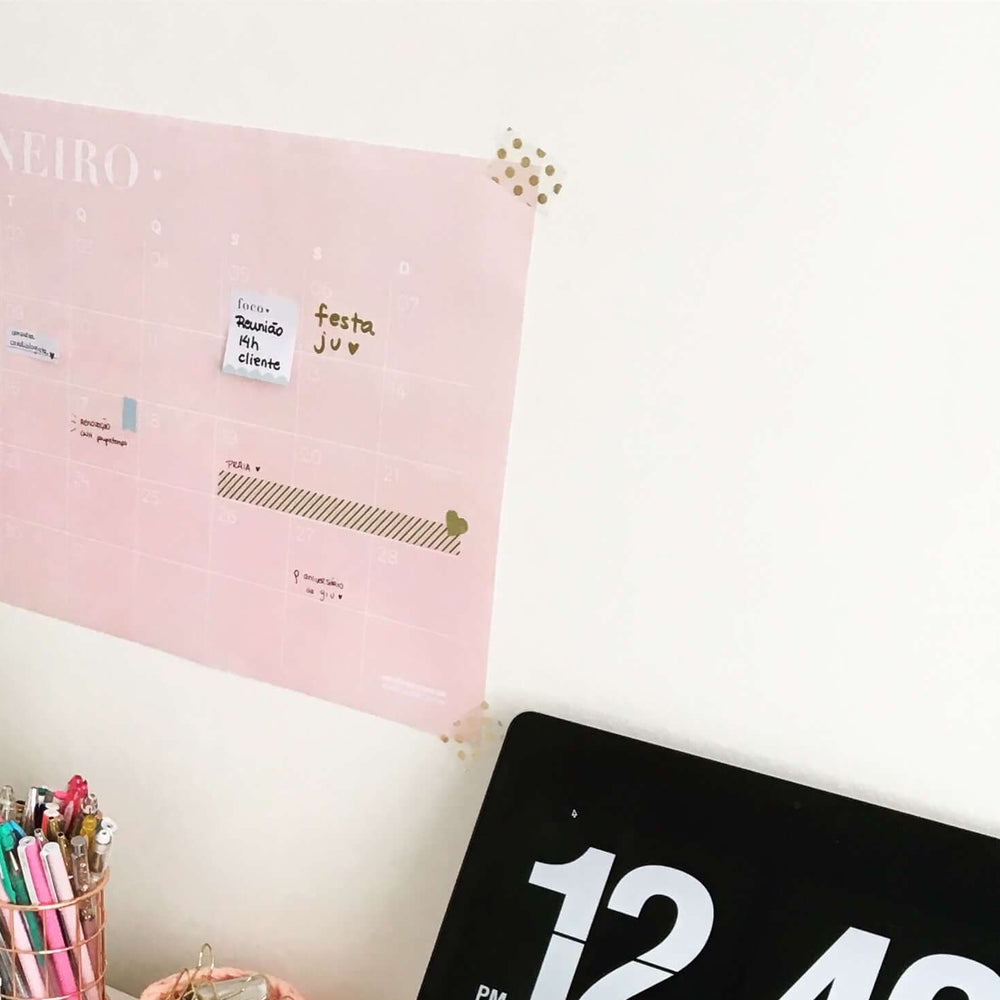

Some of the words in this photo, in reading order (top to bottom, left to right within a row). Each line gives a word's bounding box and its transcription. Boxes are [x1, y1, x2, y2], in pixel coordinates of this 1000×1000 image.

[75, 207, 87, 223] Q
[151, 219, 162, 235] Q
[399, 261, 410, 274] D
[236, 298, 265, 314] foco
[235, 315, 284, 337] Reunião
[314, 303, 375, 336] festa
[239, 334, 260, 351] 14h
[313, 331, 342, 354] ju
[238, 353, 281, 371] cliente
